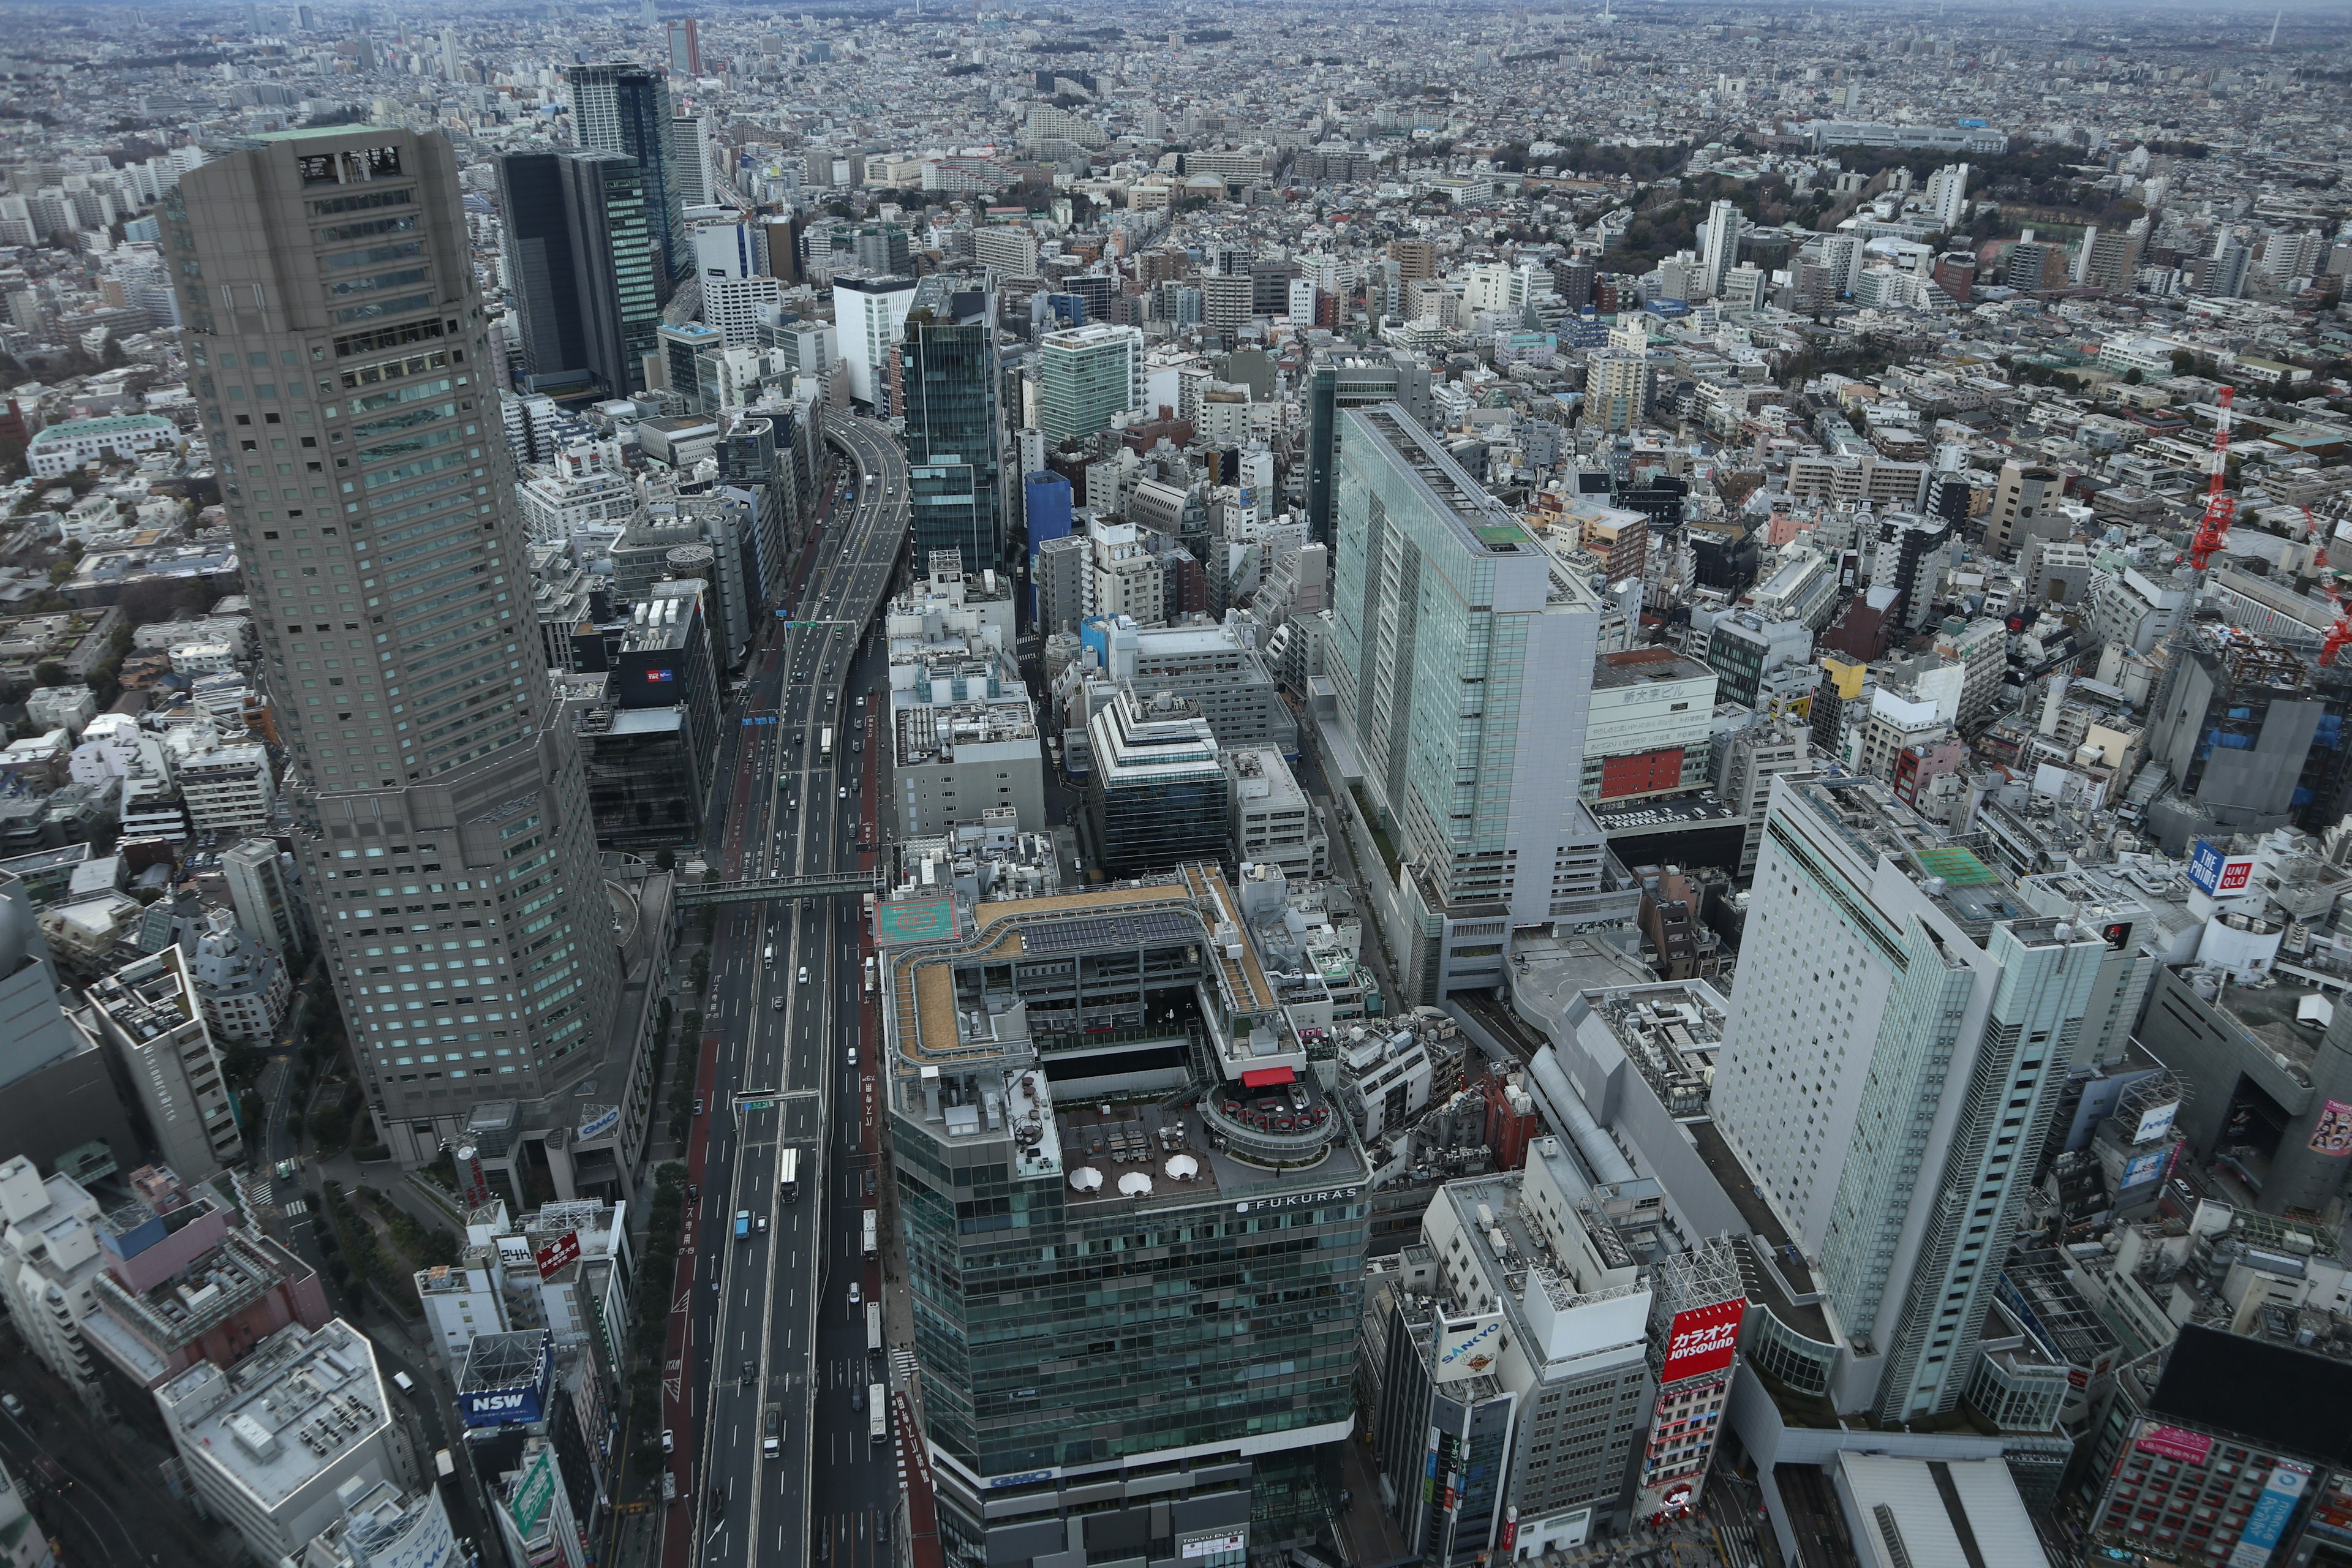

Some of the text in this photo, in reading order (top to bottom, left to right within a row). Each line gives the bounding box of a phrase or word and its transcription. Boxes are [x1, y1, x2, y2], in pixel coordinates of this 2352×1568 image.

[1876, 710, 1902, 727] 井門ビル
[1907, 722, 1934, 730] 井門ビル
[2201, 848, 2217, 871] THE
[2226, 865, 2248, 876] UNI
[2190, 859, 2217, 889] PRIME
[2223, 876, 2245, 888] QLO
[710, 974, 722, 1012] バス専用
[582, 1110, 619, 1134] GMO
[1256, 1187, 1357, 1210] FUKURAS
[541, 1242, 577, 1268] 日本経済大学
[678, 1246, 695, 1256] 17-19
[1441, 1323, 1499, 1365] SANKYO
[1672, 1322, 1737, 1349] カラオケ
[1668, 1336, 1735, 1362] JOYSOUND
[472, 1393, 524, 1412] NSW
[990, 1469, 1052, 1488] GMO
[1215, 1529, 1245, 1539] PLAZA
